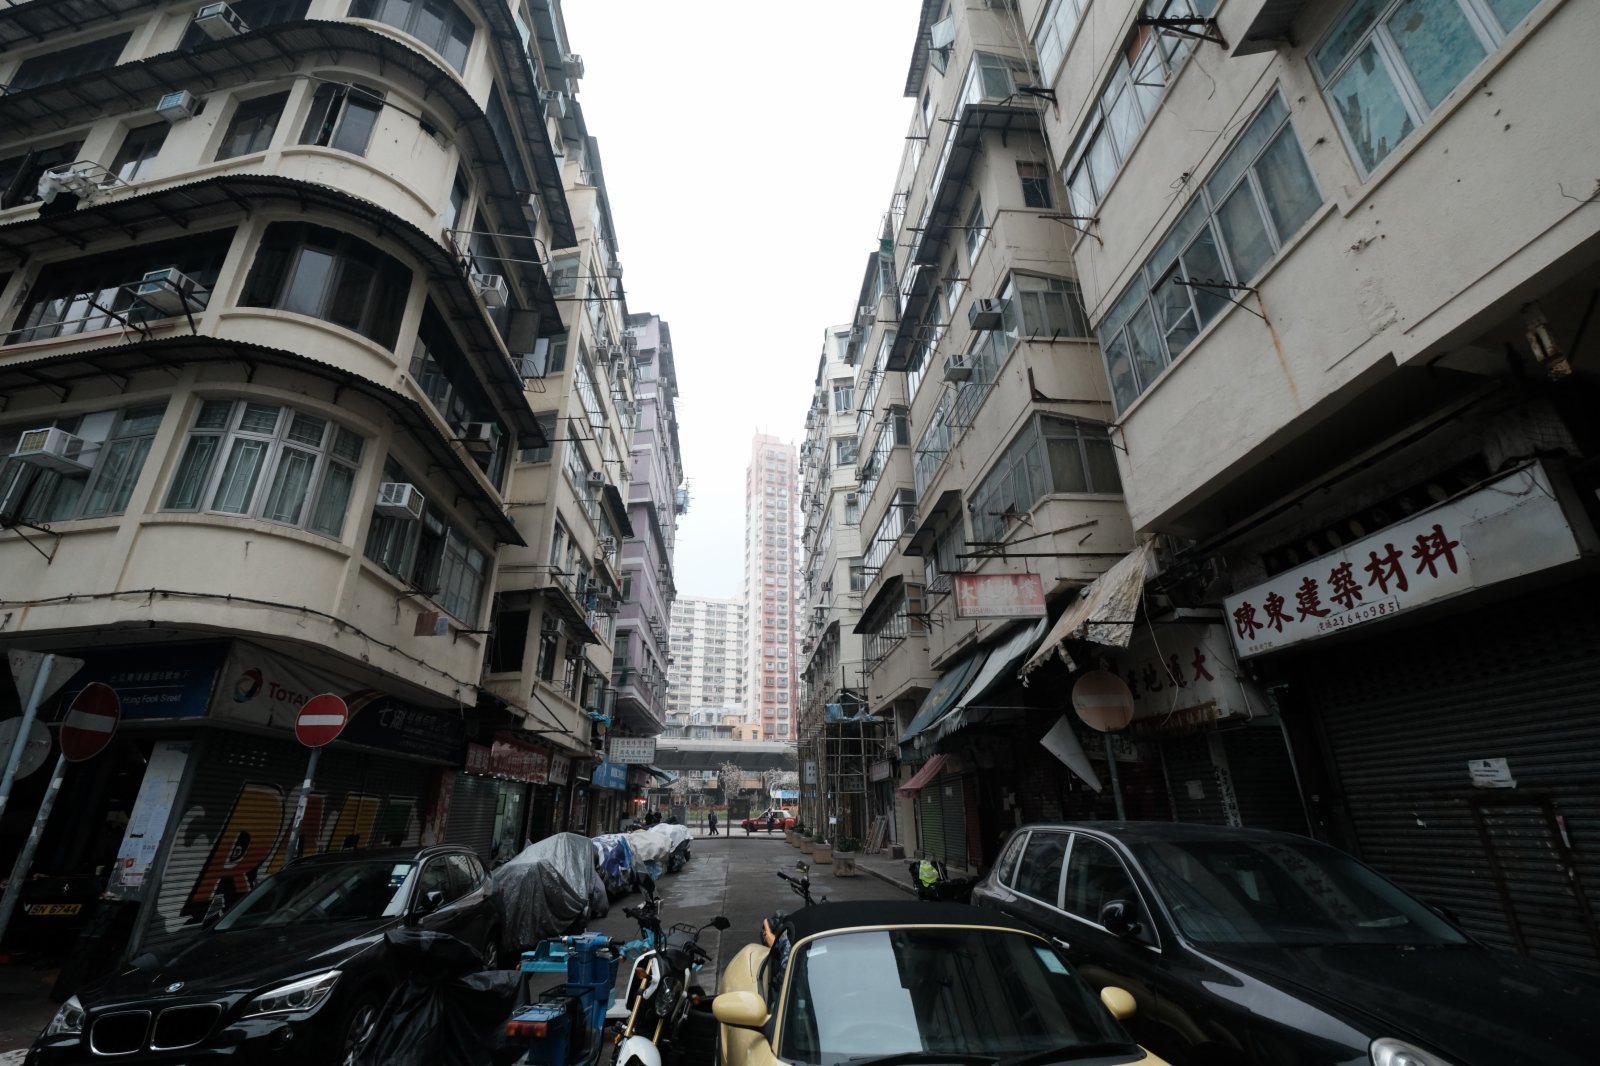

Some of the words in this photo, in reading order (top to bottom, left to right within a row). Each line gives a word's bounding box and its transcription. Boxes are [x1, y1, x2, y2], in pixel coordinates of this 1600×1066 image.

[1233, 524, 1459, 641] 陳東建築材料
[1333, 602, 1395, 626] 23640985
[49, 904, 79, 914] 6744
